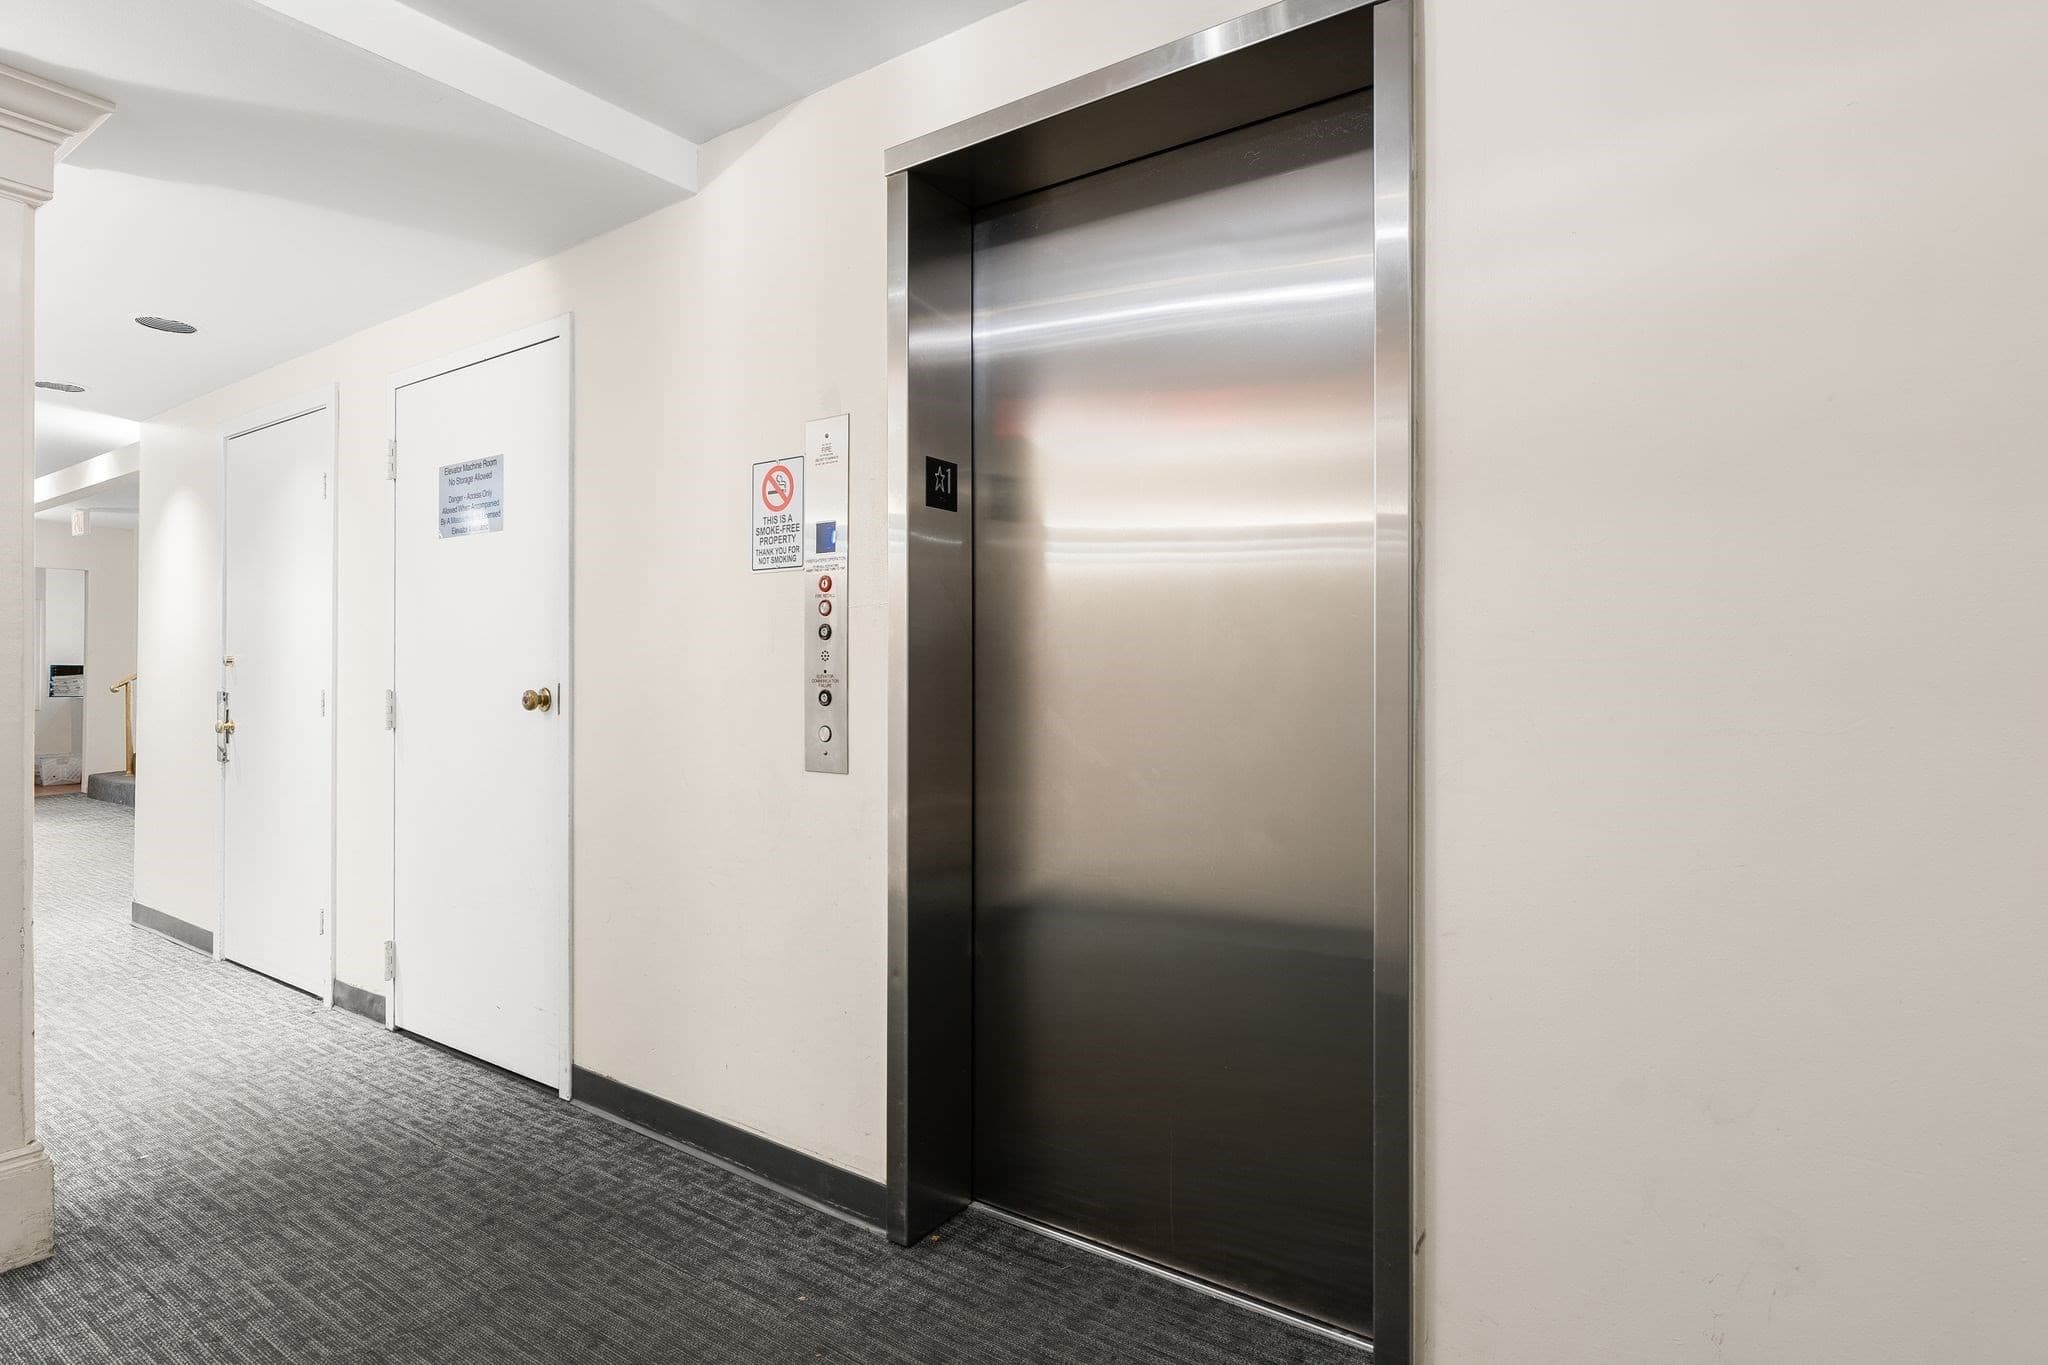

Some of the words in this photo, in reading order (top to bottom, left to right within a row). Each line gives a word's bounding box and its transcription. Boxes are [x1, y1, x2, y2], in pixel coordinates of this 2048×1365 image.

[444, 465, 462, 476] Elevator
[463, 461, 482, 472] Machine
[482, 458, 497, 468] Room
[449, 478, 455, 487] No
[456, 475, 473, 485] Storage
[474, 471, 493, 481] Allowed
[448, 494, 463, 504] Danger
[482, 489, 492, 498] Only
[763, 515, 778, 525] THIS
[779, 515, 786, 524] IS
[787, 514, 793, 523] A
[755, 523, 800, 537] SMOKE-FREE
[759, 534, 796, 546] PROPERTY
[755, 548, 774, 557] THANK
[775, 546, 787, 555] YOU
[788, 545, 800, 554] FOR
[758, 556, 769, 565] NOT
[770, 554, 797, 564] SMOKING
